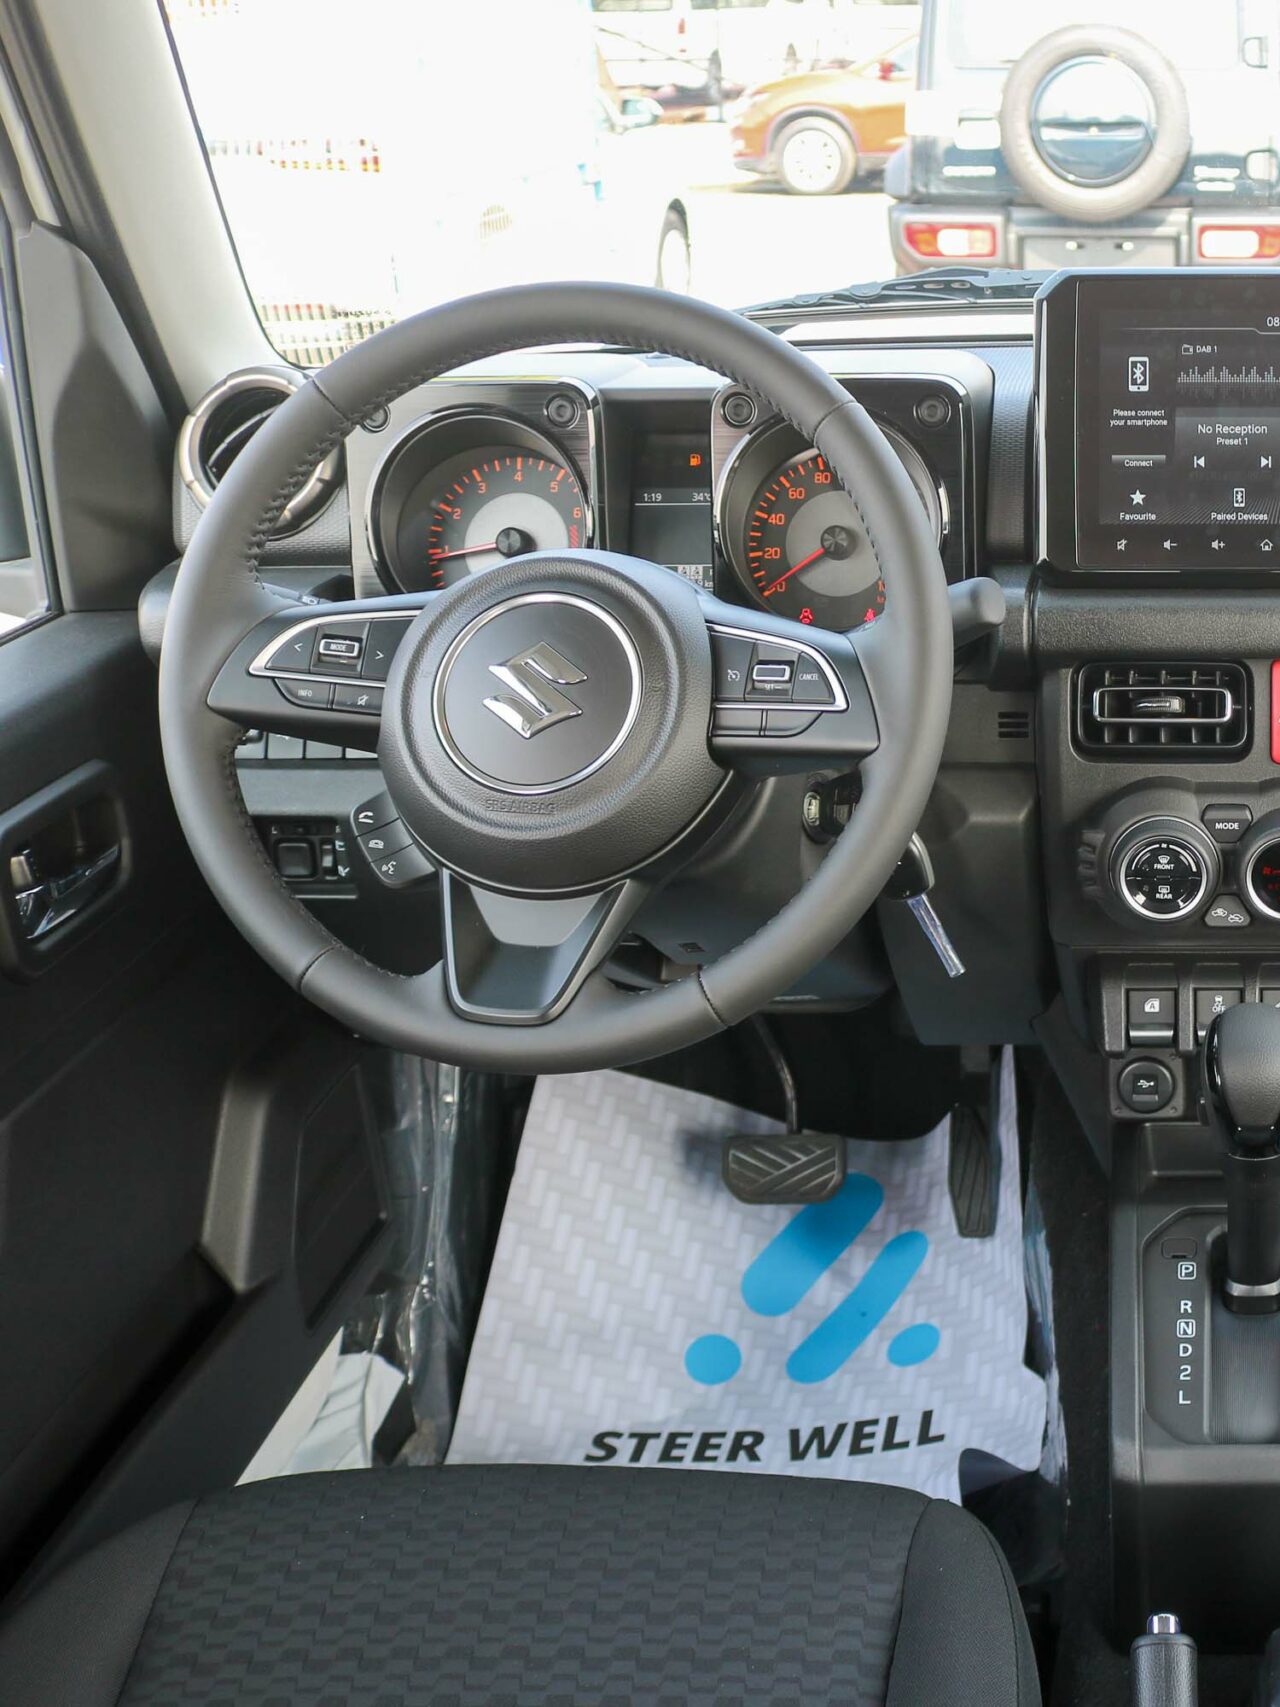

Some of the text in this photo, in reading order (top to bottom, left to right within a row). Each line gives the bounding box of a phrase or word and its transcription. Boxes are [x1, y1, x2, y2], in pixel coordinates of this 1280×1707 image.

[1196, 345, 1212, 353] DAB
[1113, 409, 1165, 417] Please connect
[1110, 418, 1168, 427] your smartphone
[1198, 424, 1268, 436] No Reception
[1216, 437, 1242, 446] Preset
[1124, 459, 1153, 467] Connect
[514, 471, 523, 482] 4
[814, 472, 831, 484] 80
[477, 482, 487, 494] 3
[550, 481, 559, 493] 5
[643, 492, 662, 502] 1:19
[788, 487, 805, 500] 60
[452, 508, 462, 520] 2
[573, 507, 582, 519] 6
[1119, 512, 1157, 521] Favourite
[1211, 512, 1268, 521] Paired Devices
[768, 513, 785, 526] 40
[764, 547, 780, 559] 20
[329, 643, 347, 652] MODE
[799, 673, 819, 681] CANCEL
[297, 689, 313, 697] INFO
[1215, 822, 1239, 830] MODE
[1153, 863, 1175, 871] FRONT
[1180, 1264, 1194, 1278] P
[1180, 1300, 1193, 1314] R
[1179, 1321, 1194, 1336] N
[1179, 1343, 1193, 1357] D
[1179, 1365, 1192, 1380] 2
[1178, 1390, 1191, 1404] L
[584, 1409, 946, 1463] STEER WELL
